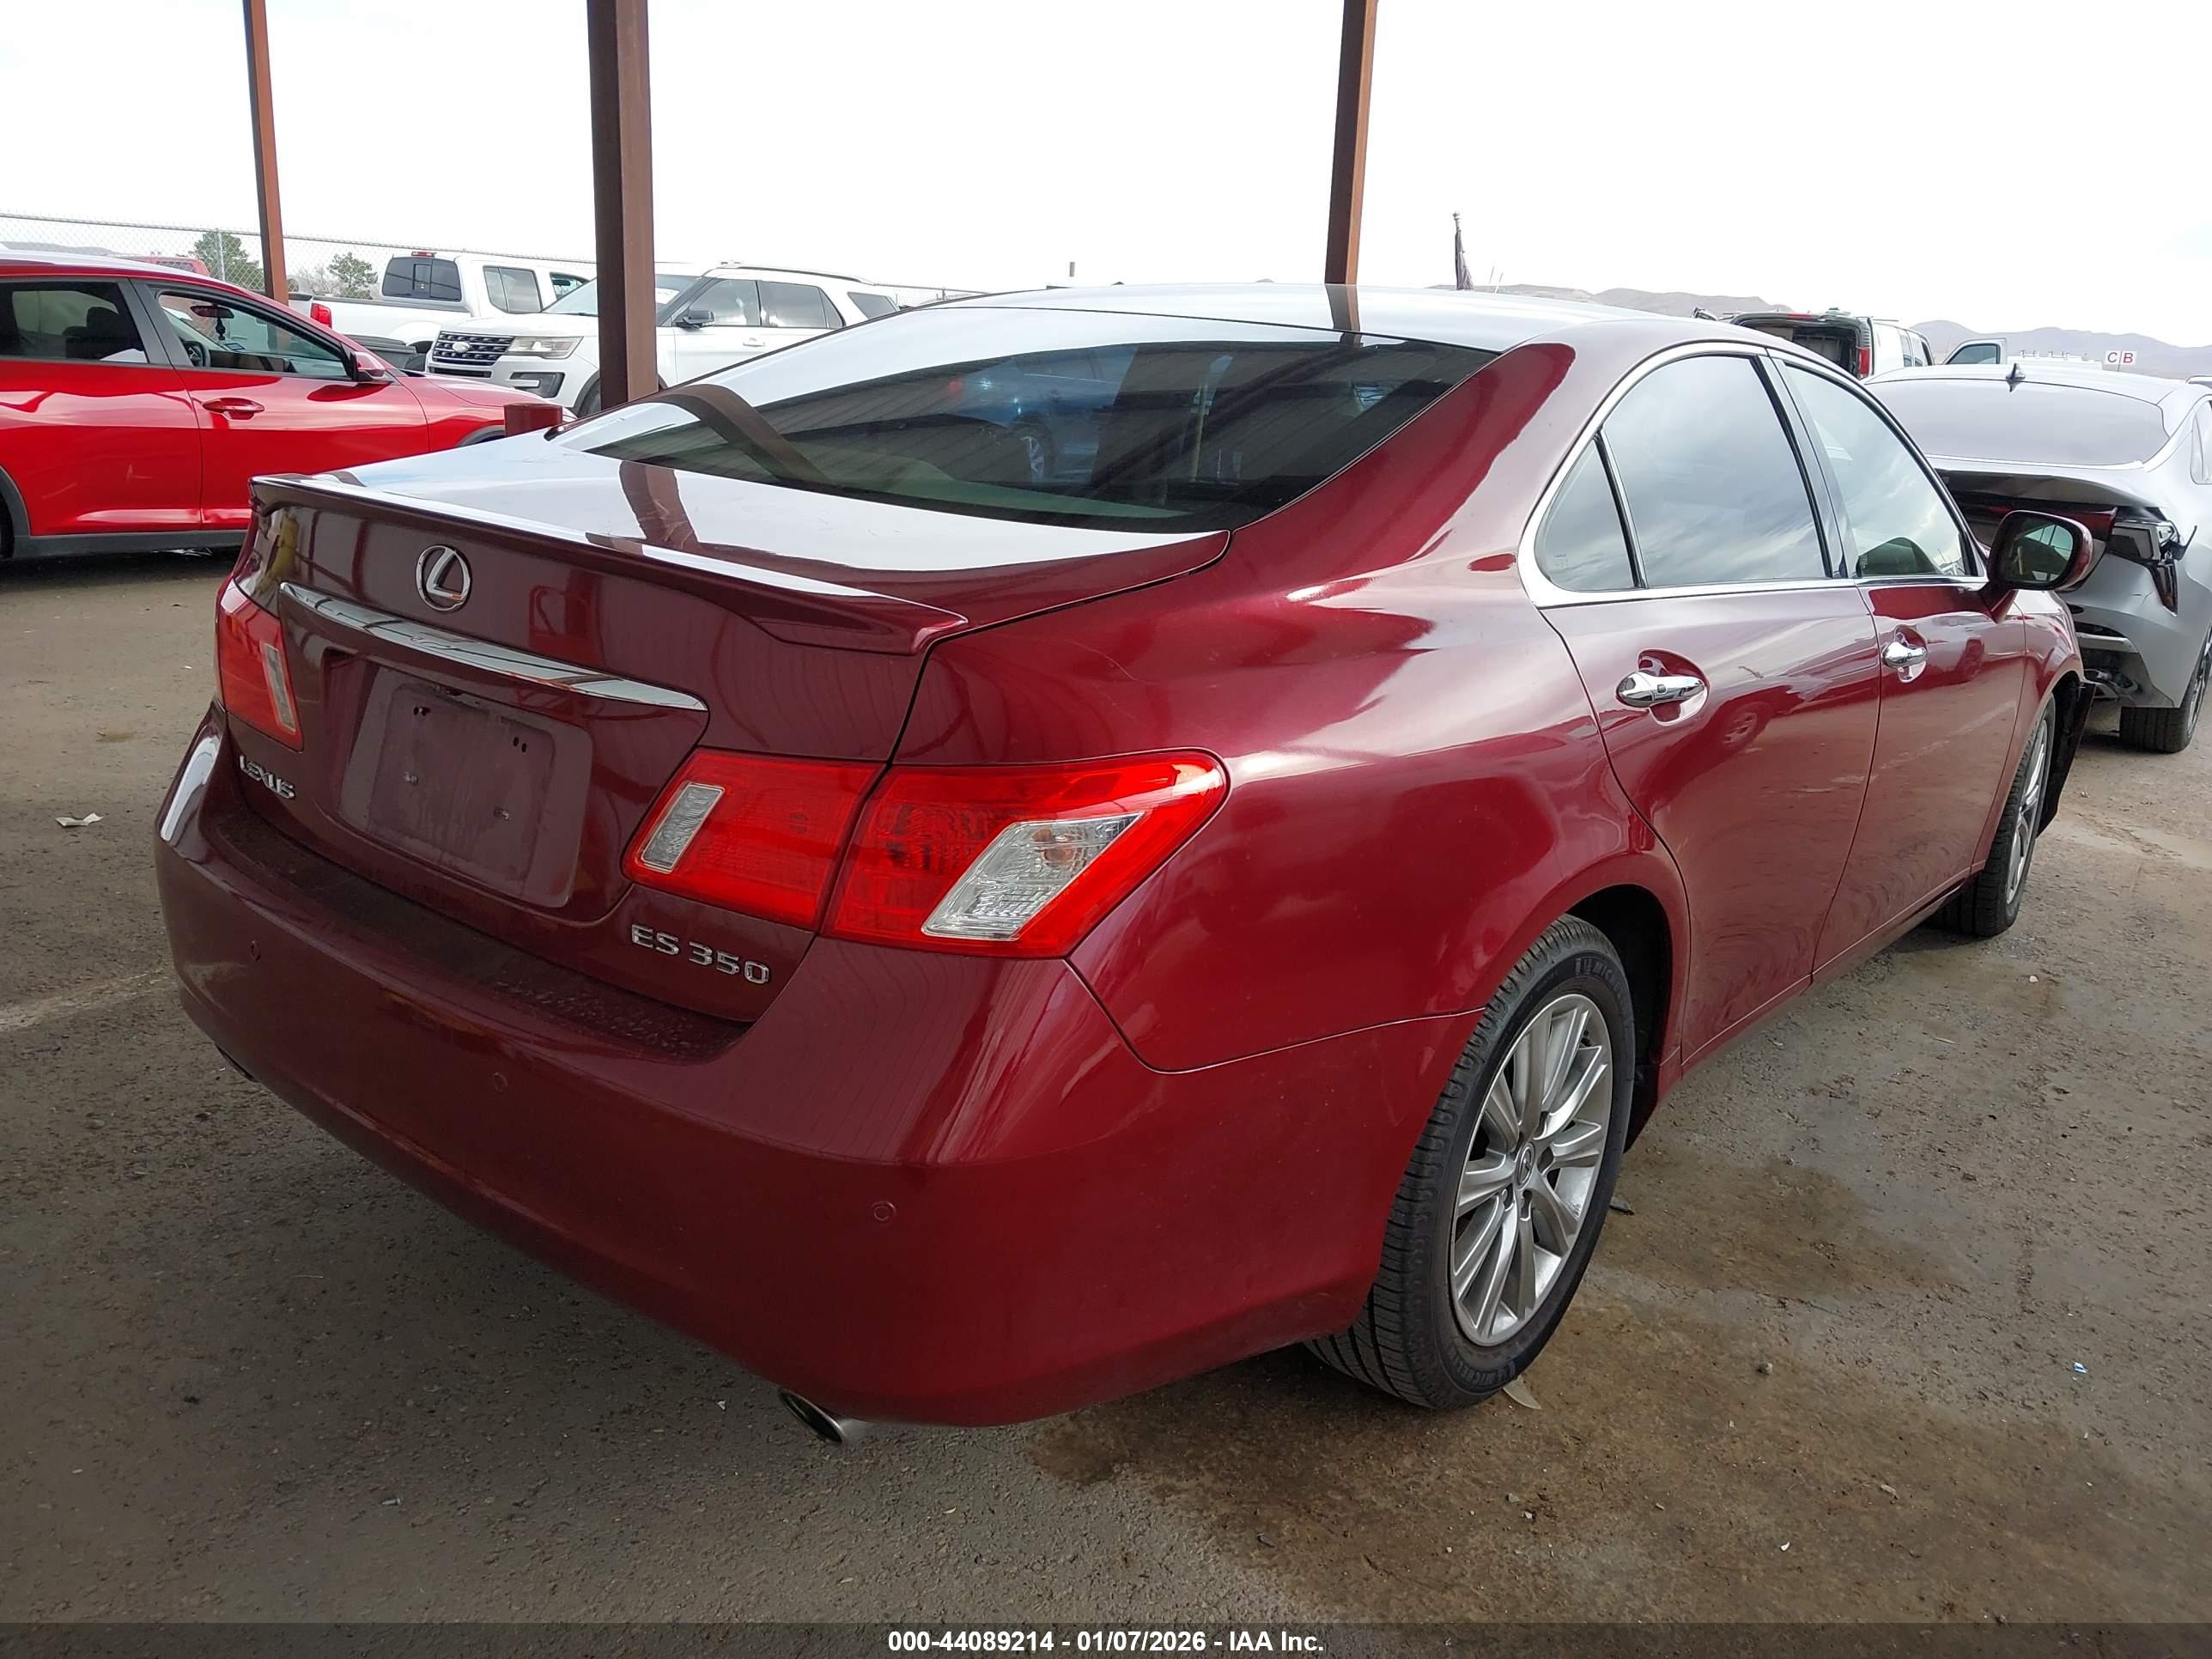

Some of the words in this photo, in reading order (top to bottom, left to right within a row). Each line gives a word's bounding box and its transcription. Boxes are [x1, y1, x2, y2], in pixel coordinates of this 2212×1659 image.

[2107, 351, 2118, 363] C
[2123, 352, 2134, 363] B
[239, 755, 295, 799] LEXUS
[631, 923, 680, 956] ES
[688, 940, 770, 985] 350
